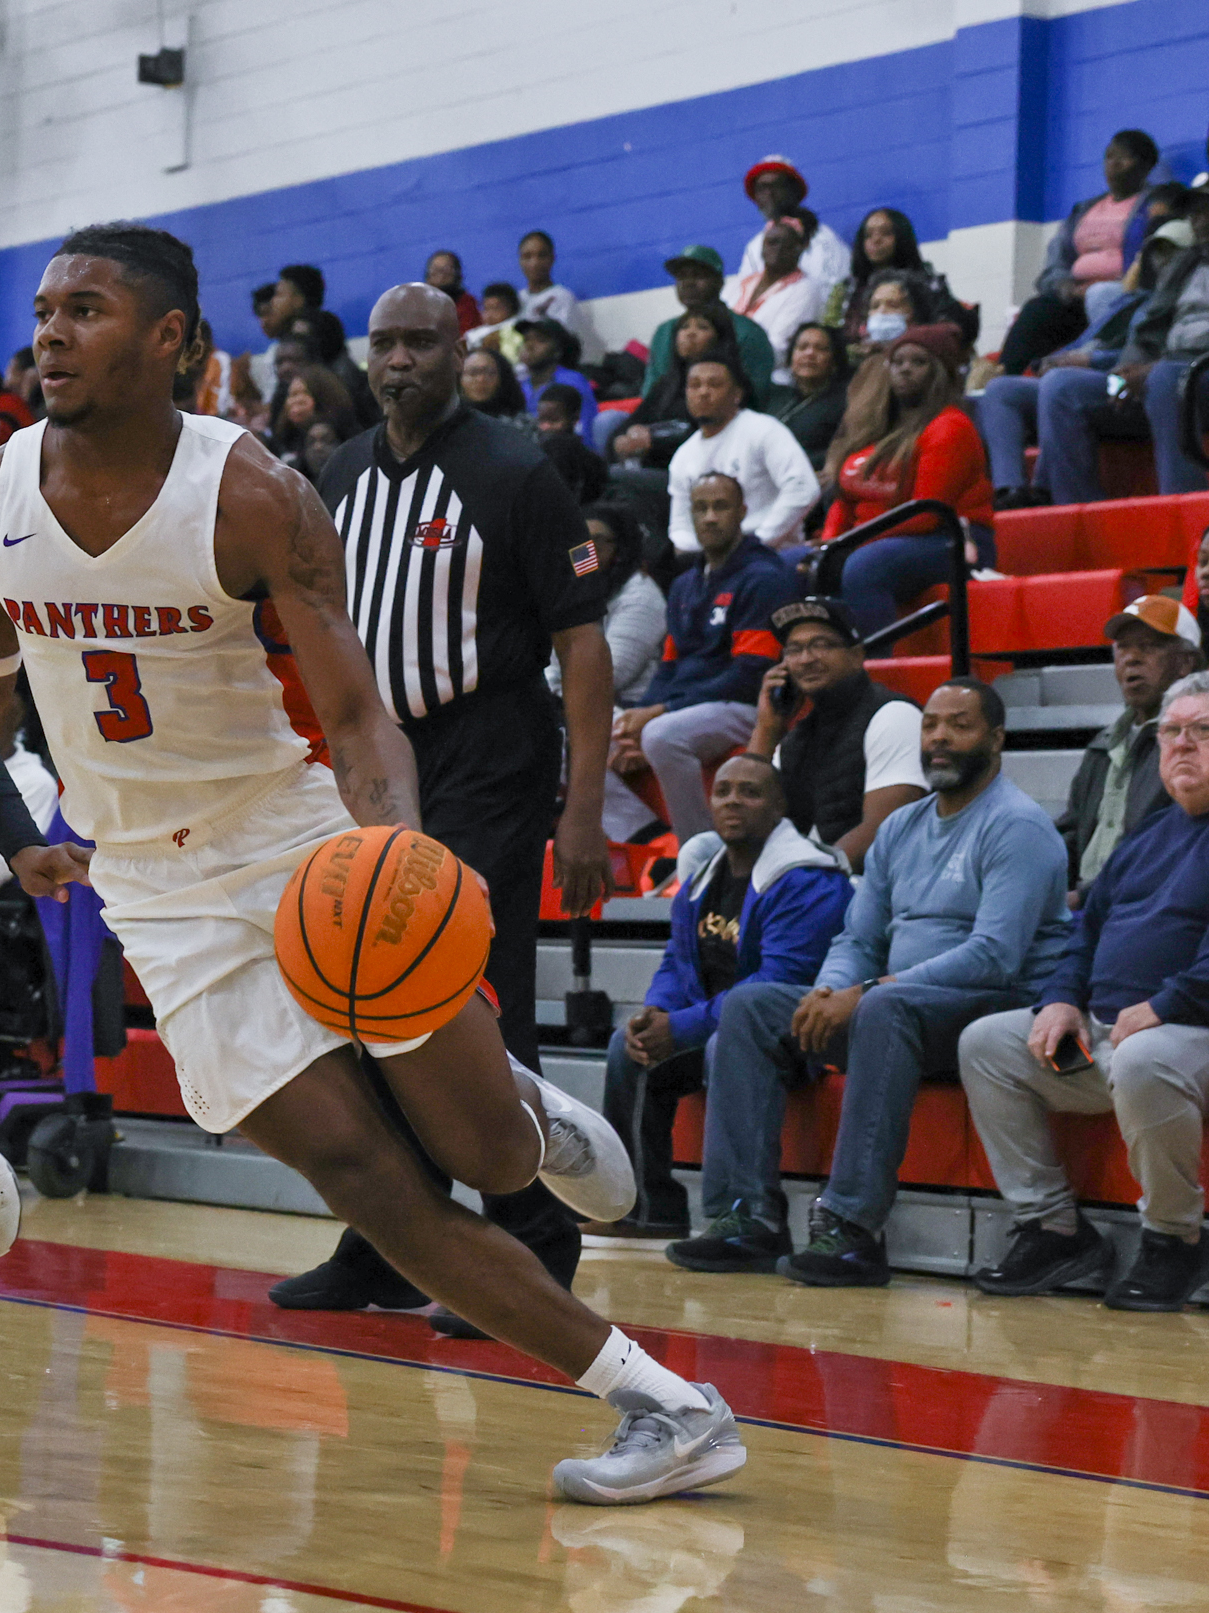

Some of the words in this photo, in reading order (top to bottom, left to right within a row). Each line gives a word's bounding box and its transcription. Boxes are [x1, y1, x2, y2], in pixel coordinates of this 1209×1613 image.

[3, 597, 215, 640] PANTHERS
[81, 649, 154, 744] 3
[374, 835, 448, 946] Wilson
